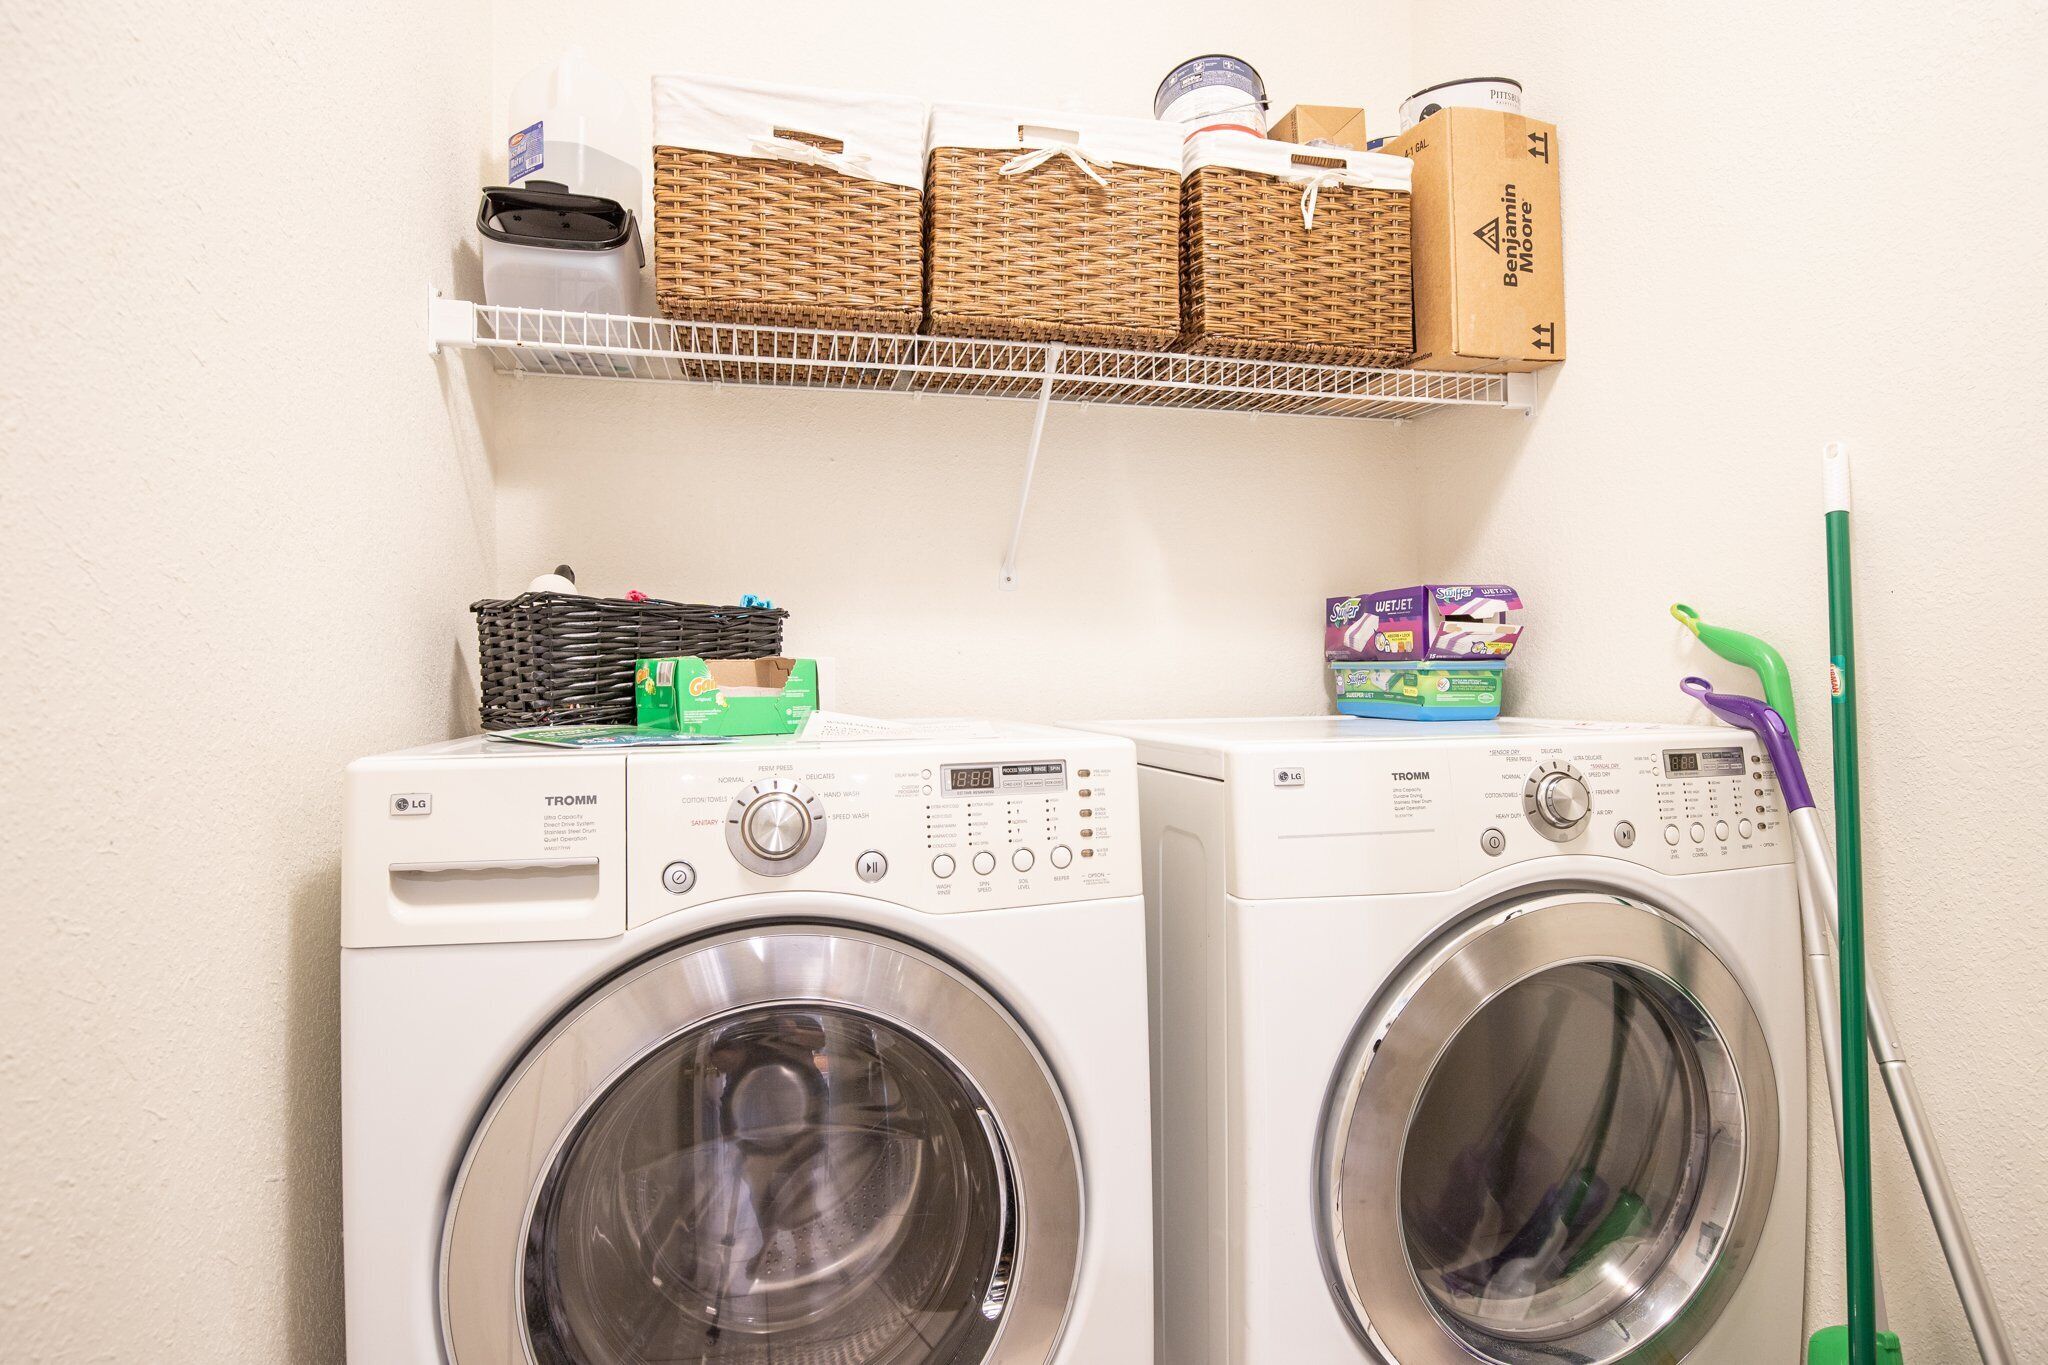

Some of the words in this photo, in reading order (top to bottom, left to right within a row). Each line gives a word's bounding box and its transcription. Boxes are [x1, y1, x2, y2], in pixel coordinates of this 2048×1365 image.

[1490, 89, 1520, 105] PITTSBU
[1501, 183, 1521, 287] Benjamin
[1519, 201, 1533, 273] Moore
[1436, 587, 1474, 601] Swiffer
[1330, 602, 1360, 624] Swiffer
[1376, 598, 1412, 613] WETJET
[1347, 673, 1368, 686] Swiffer
[1291, 772, 1302, 780] LG
[1392, 772, 1430, 781] TROMM
[412, 800, 426, 808] LG
[545, 795, 597, 806] TROMM
